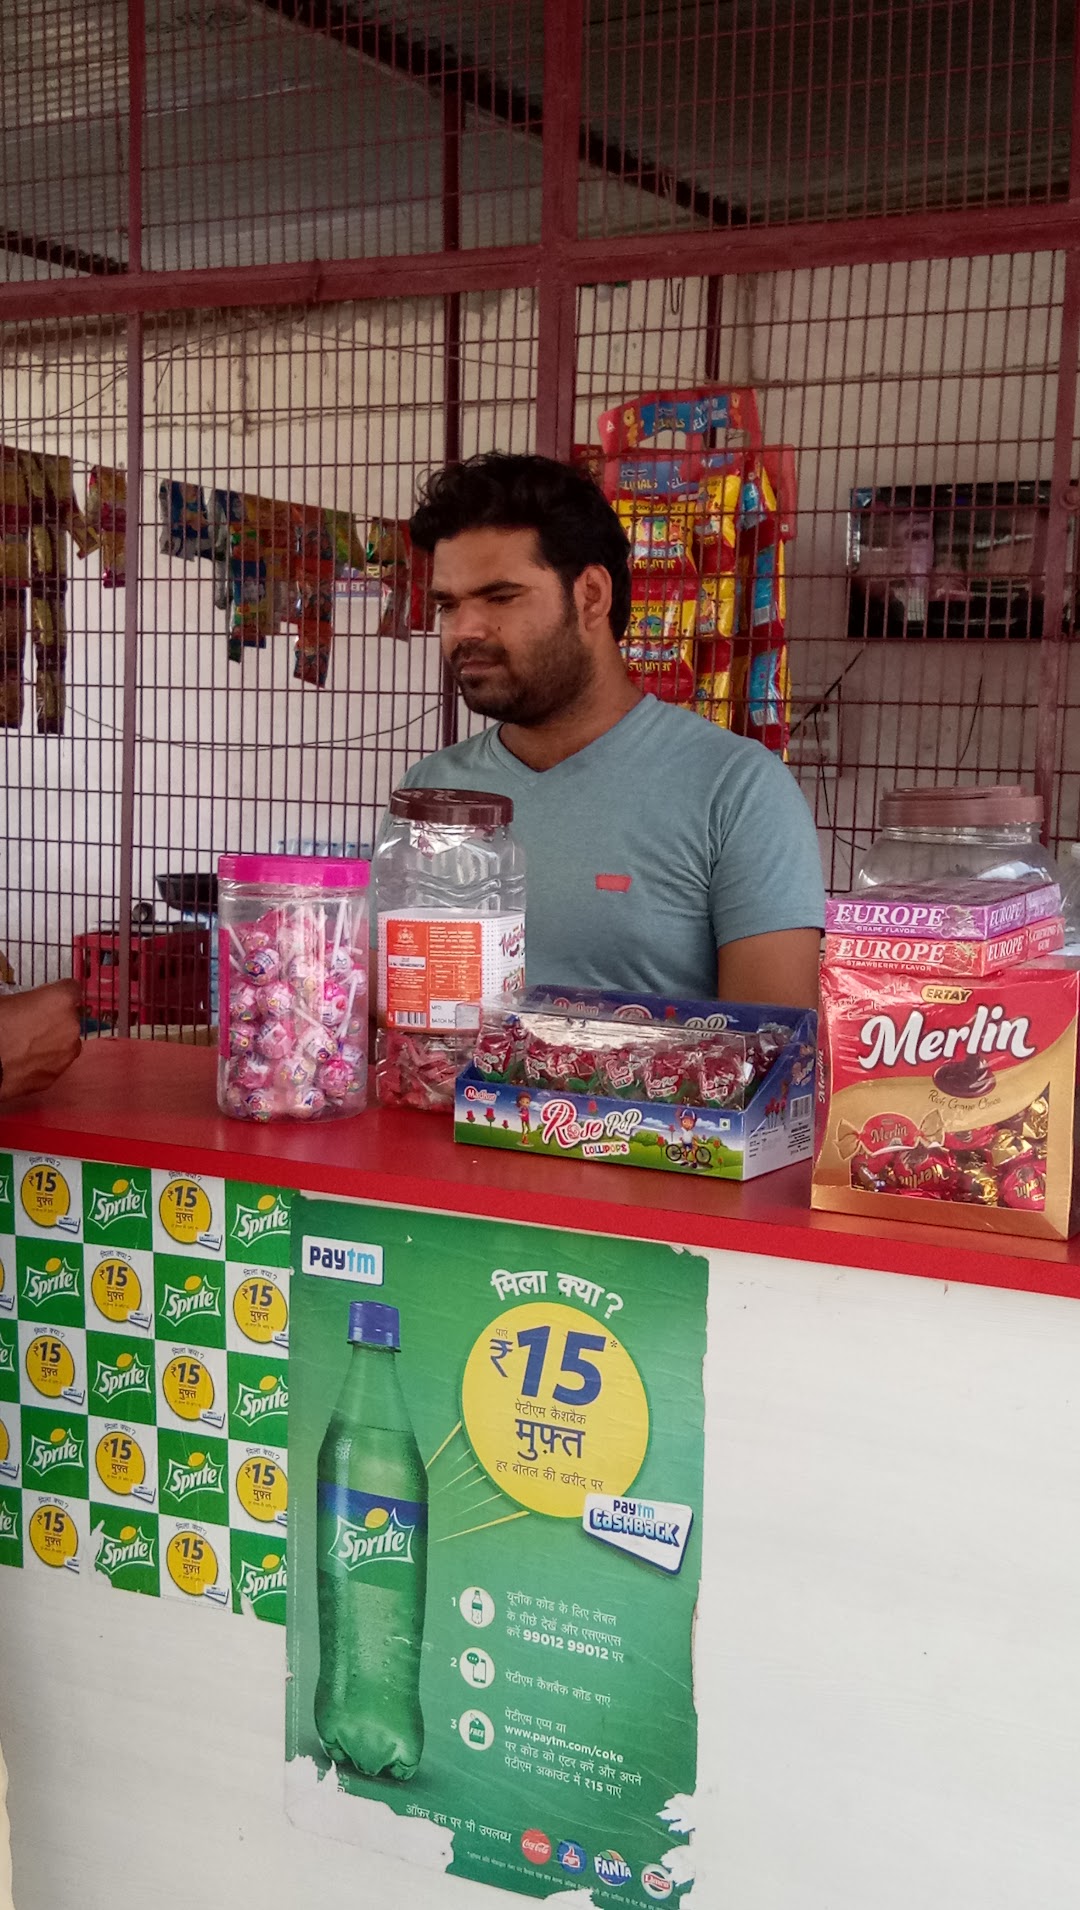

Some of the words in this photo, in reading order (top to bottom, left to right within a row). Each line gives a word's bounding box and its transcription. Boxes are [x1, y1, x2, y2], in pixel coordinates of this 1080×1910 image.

[834, 904, 945, 927] EUROPE
[989, 901, 1023, 928] EUROPE
[836, 938, 945, 964] EUROPE
[988, 934, 1023, 962] EUROPE
[847, 960, 898, 969] STRAWBERRY
[902, 964, 932, 972] FLAVOR
[926, 987, 971, 1001] ERTAY
[858, 1006, 1035, 1070] Merlin
[541, 1099, 604, 1148] Rose
[871, 1122, 909, 1144] Merlin
[584, 1143, 628, 1155] LOLLIPOPS
[94, 1188, 141, 1223] Sprite
[237, 1205, 288, 1240] Sprite
[28, 1267, 74, 1300] Sprite
[490, 1269, 548, 1301] मिला
[166, 1286, 215, 1320] Sprite
[99, 1362, 145, 1396] Sprite
[240, 1385, 288, 1419] Sprite
[515, 1398, 546, 1418] पेटीएम
[550, 1406, 586, 1425] कैशबैक
[33, 1438, 78, 1469] Sprite
[170, 1462, 217, 1494] Sprite
[496, 1460, 508, 1473] हर
[512, 1461, 538, 1478] बोतल
[543, 1467, 556, 1481] की
[560, 1472, 587, 1489] खरीद
[591, 1479, 604, 1491] पर
[102, 1536, 148, 1568] Sprite
[338, 1523, 404, 1563] Sprite
[451, 1597, 457, 1607] 1
[506, 1590, 532, 1606] यूनीक
[536, 1596, 555, 1611] कोड
[558, 1600, 568, 1614] के
[572, 1603, 589, 1620] लिए
[593, 1609, 617, 1626] लेबल
[506, 1607, 516, 1621] के
[520, 1611, 537, 1626] पीछे
[562, 1622, 578, 1636] और
[582, 1627, 621, 1646] एसएमएस
[506, 1624, 521, 1638] करें
[523, 1629, 563, 1649] 99012
[567, 1639, 609, 1660] 99012
[612, 1649, 624, 1663] पर
[450, 1658, 457, 1668] 2
[505, 1669, 533, 1687] पेटीएम
[536, 1677, 569, 1695] कैशबैक
[572, 1687, 592, 1701] कोड
[450, 1719, 457, 1729] 3
[505, 1706, 532, 1725] पेटीएम
[556, 1722, 566, 1734] या
[505, 1725, 624, 1763] www.paytm.com/coke
[505, 1740, 517, 1752] पर
[520, 1743, 539, 1758] कोड
[542, 1749, 555, 1762] को
[559, 1753, 576, 1769] एंटर
[580, 1760, 594, 1773] करें
[598, 1764, 616, 1779] और
[620, 1771, 642, 1786] अपने
[505, 1754, 532, 1772] पेटीएम
[536, 1765, 570, 1783] अकाउंट
[573, 1772, 581, 1786] में
[433, 1811, 447, 1824] इस
[450, 1817, 462, 1829] पर
[465, 1819, 476, 1833] भी
[479, 1825, 512, 1843] उपलब्ध
[594, 1856, 632, 1878] FANTA
